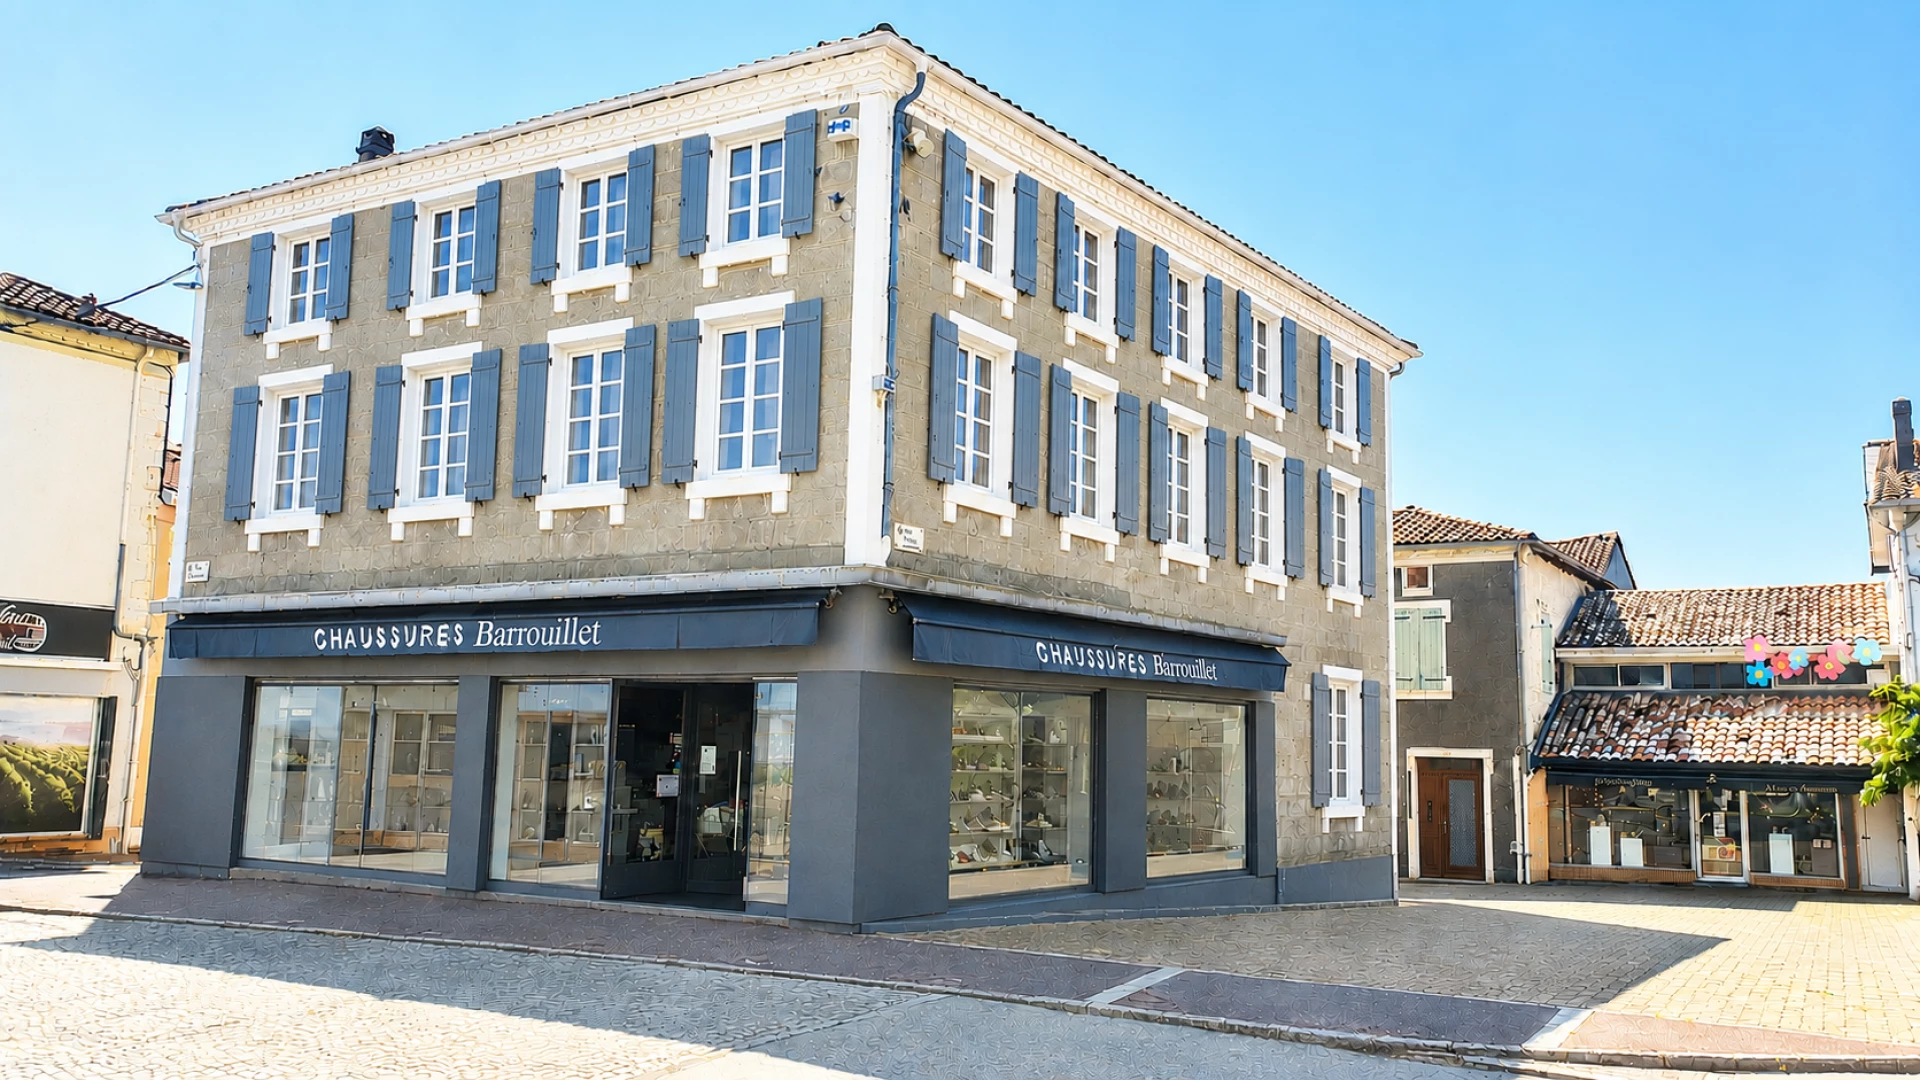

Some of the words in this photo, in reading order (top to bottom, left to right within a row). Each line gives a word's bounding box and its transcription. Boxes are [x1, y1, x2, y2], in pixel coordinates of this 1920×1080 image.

[314, 623, 464, 650] CHAUSSURES
[473, 617, 602, 647] Barrouillet
[1035, 641, 1147, 674] CHAUSSURES
[1153, 653, 1218, 681] Barrouillet
